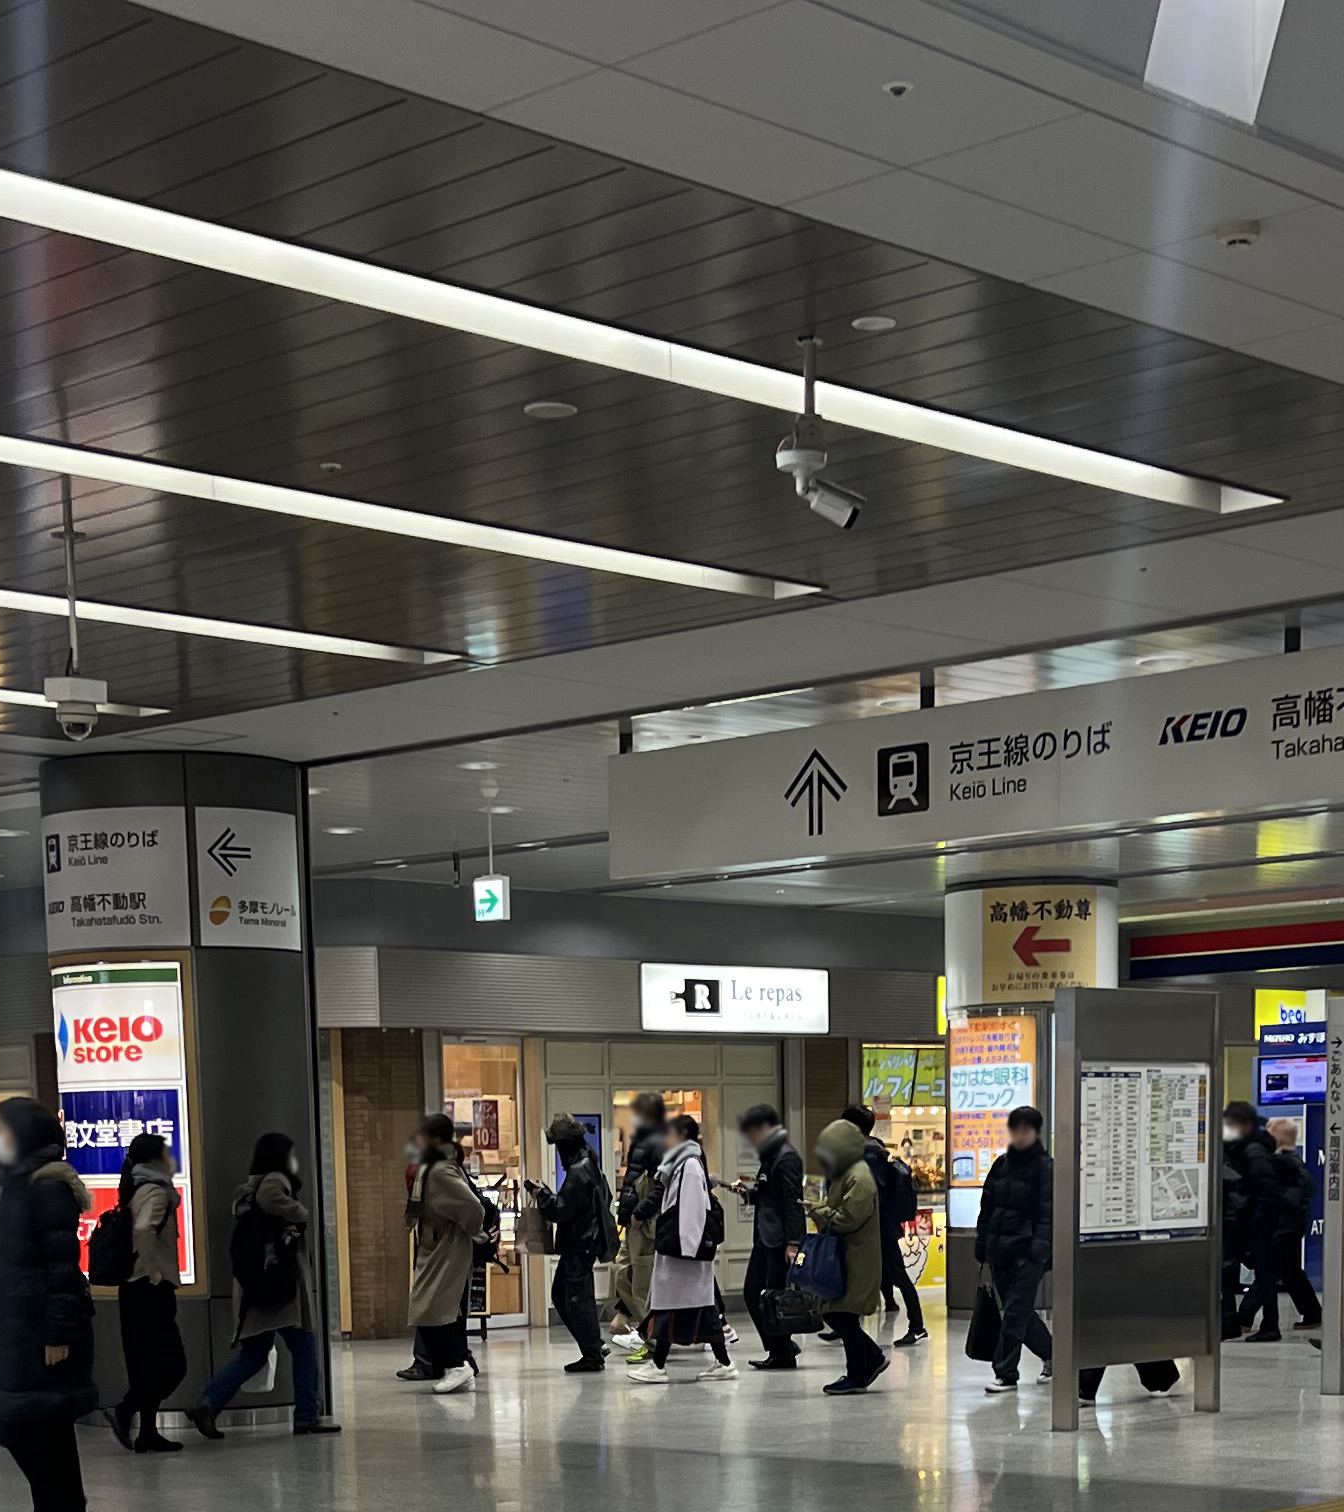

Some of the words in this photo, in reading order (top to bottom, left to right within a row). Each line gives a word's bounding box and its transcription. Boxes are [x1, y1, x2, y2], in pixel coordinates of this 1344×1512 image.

[1158, 707, 1248, 746] KEIO
[948, 721, 1113, 775] 京王線のりば
[991, 776, 1028, 796] Line
[67, 829, 159, 852] 京王線のりば
[88, 854, 109, 866] Line
[70, 892, 147, 914] 高幡不動駅
[990, 898, 1092, 923] 高幡不動尊
[731, 979, 753, 1000] Le
[759, 986, 803, 1007] repas
[73, 1044, 144, 1064] store
[958, 1088, 1015, 1109] クリニック
[1311, 1219, 1324, 1235] AT
